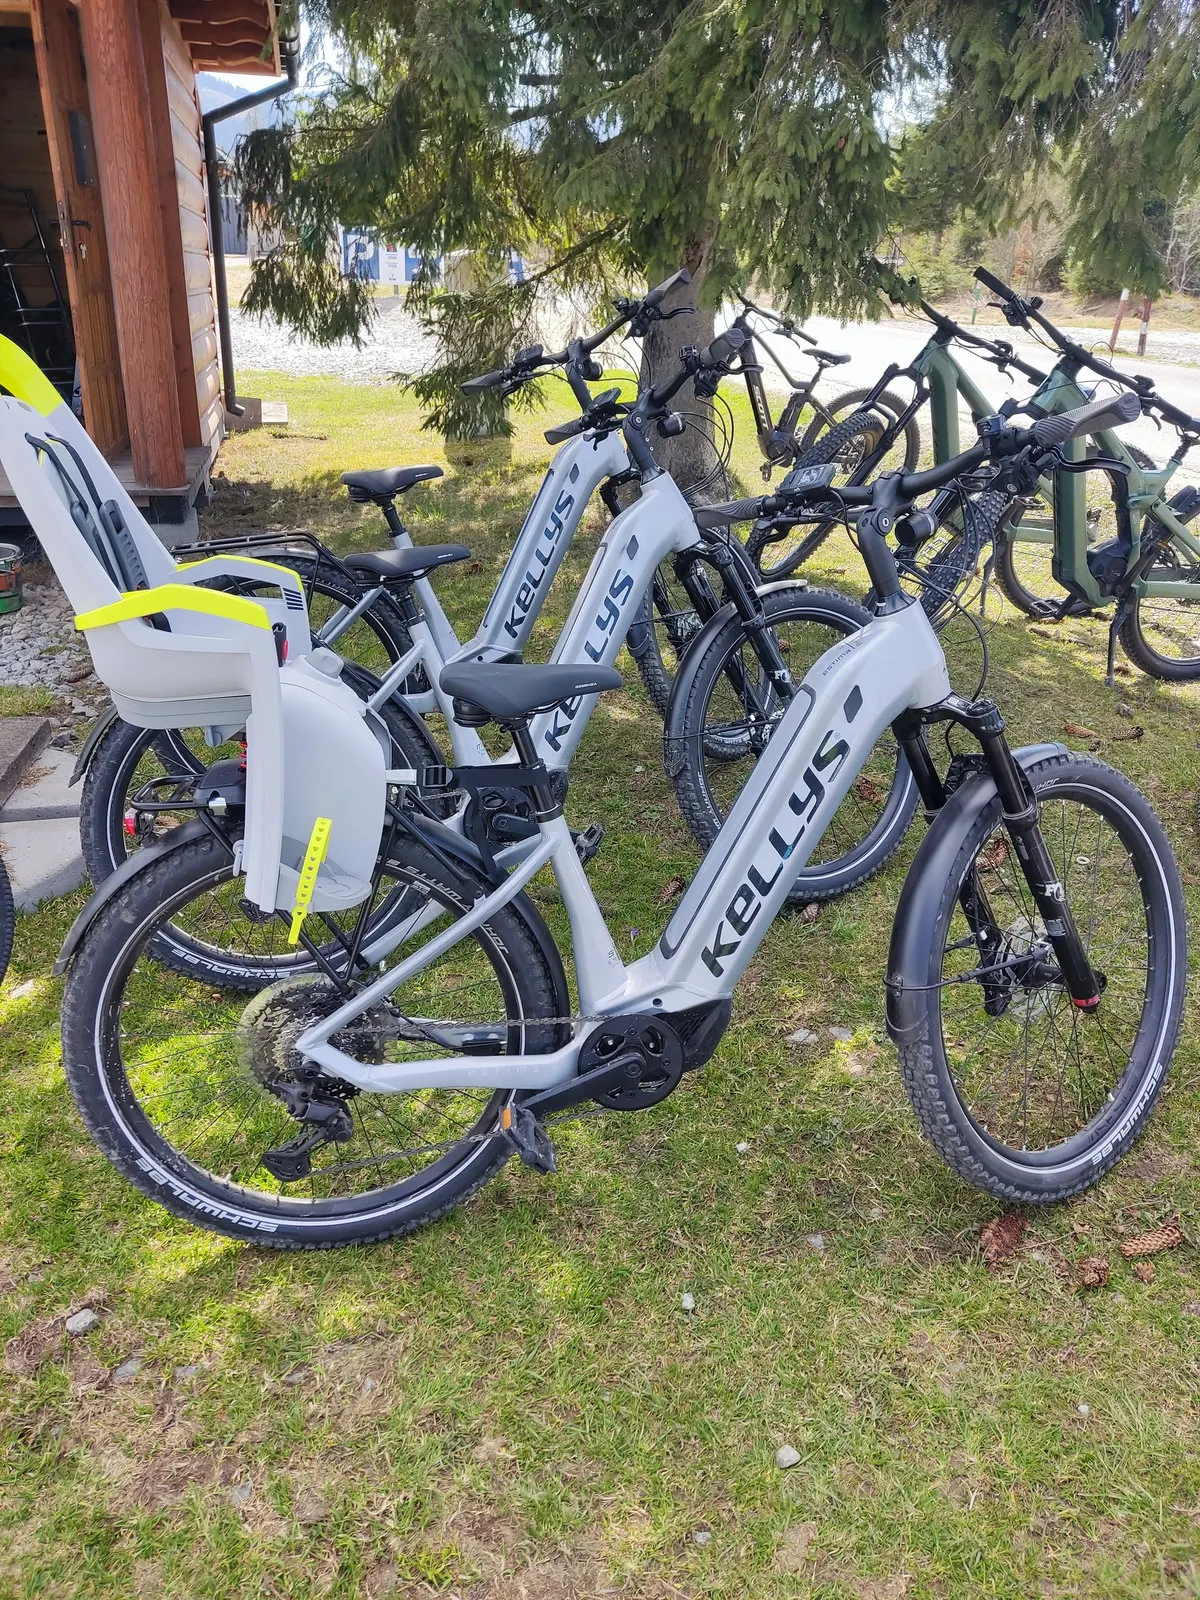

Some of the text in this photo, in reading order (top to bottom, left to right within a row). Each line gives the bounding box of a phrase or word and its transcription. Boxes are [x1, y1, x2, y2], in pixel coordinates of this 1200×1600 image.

[753, 384, 770, 431] SCOTT
[171, 948, 292, 979] SCHWALBE
[1091, 1062, 1164, 1166] SCHWALBE
[134, 1157, 280, 1233] SCHWALBE
